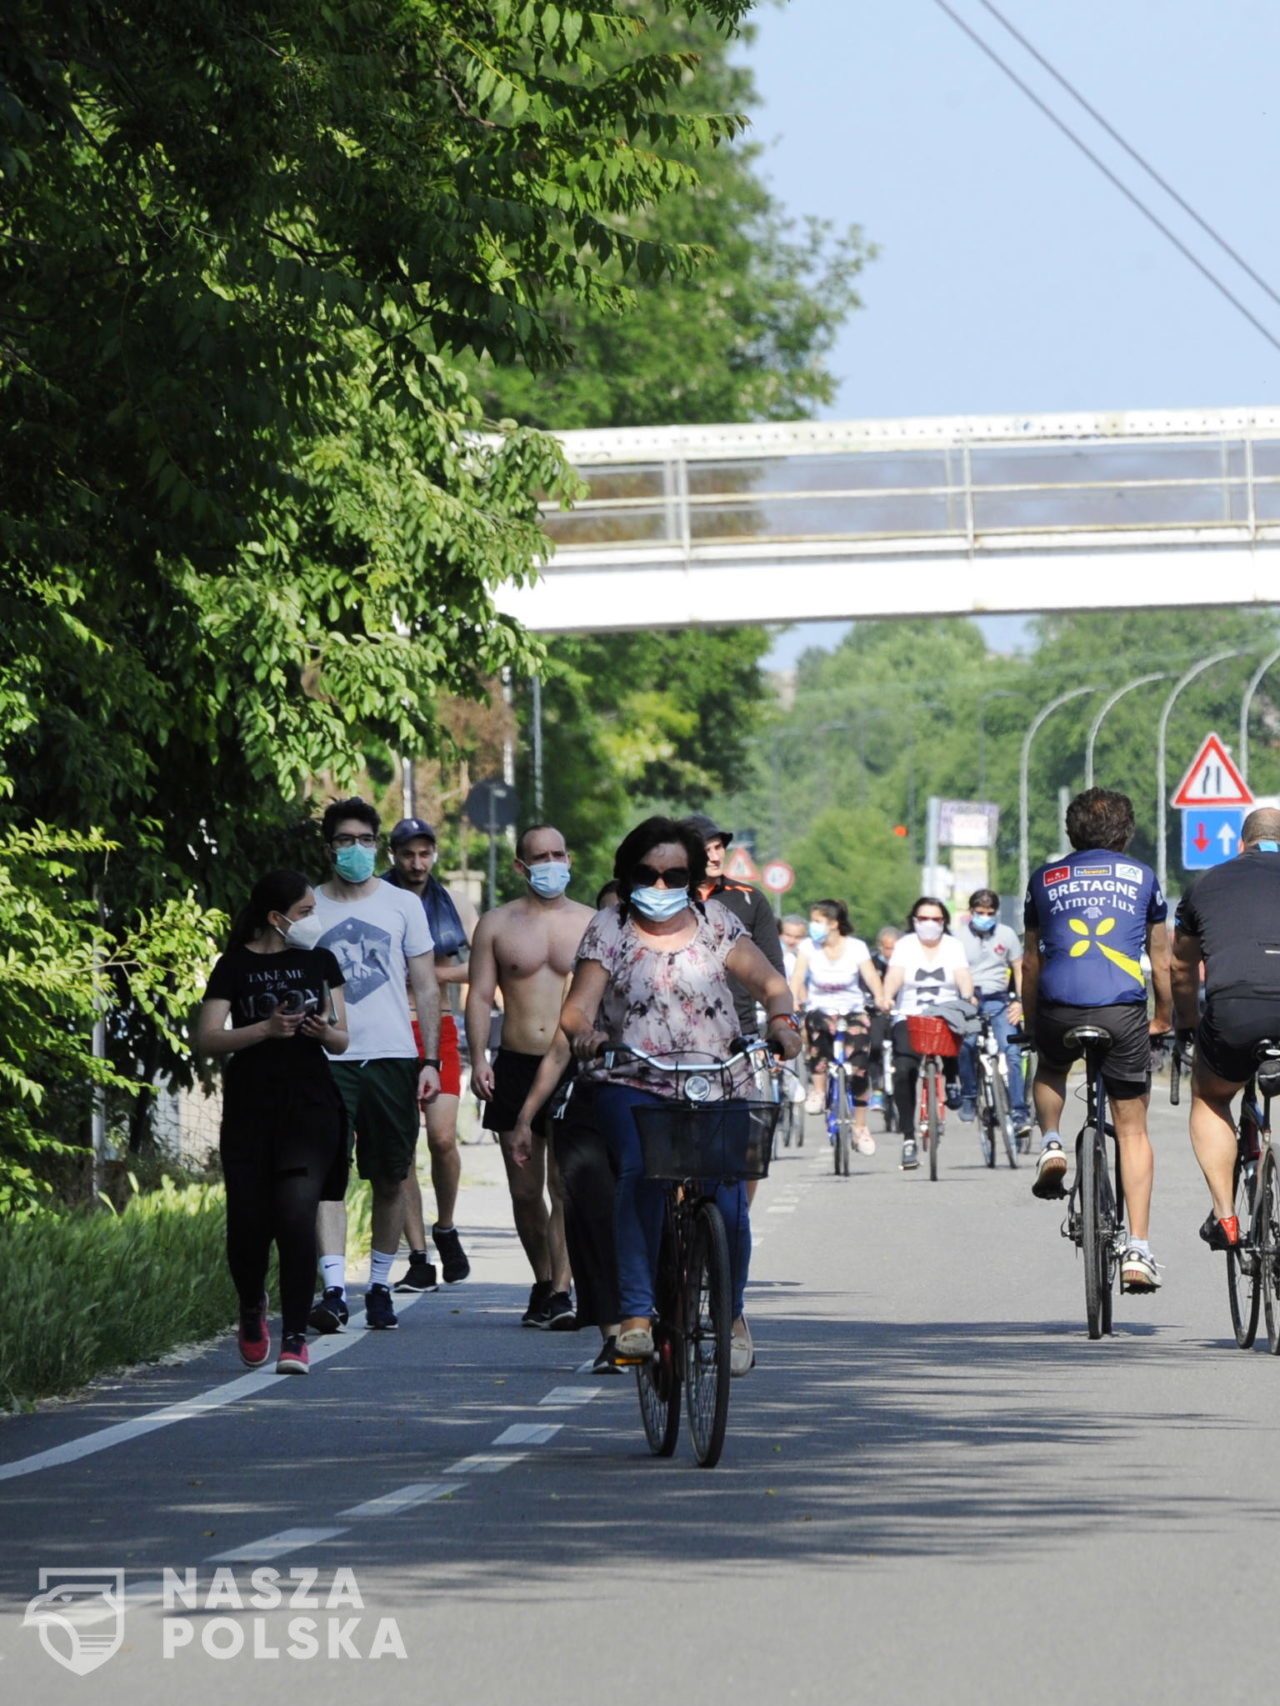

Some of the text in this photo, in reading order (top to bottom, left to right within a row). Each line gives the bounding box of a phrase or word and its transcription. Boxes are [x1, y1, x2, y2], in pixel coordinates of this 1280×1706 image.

[1048, 880, 1138, 901] BRETAGNE
[247, 969, 304, 983] TAKE ME
